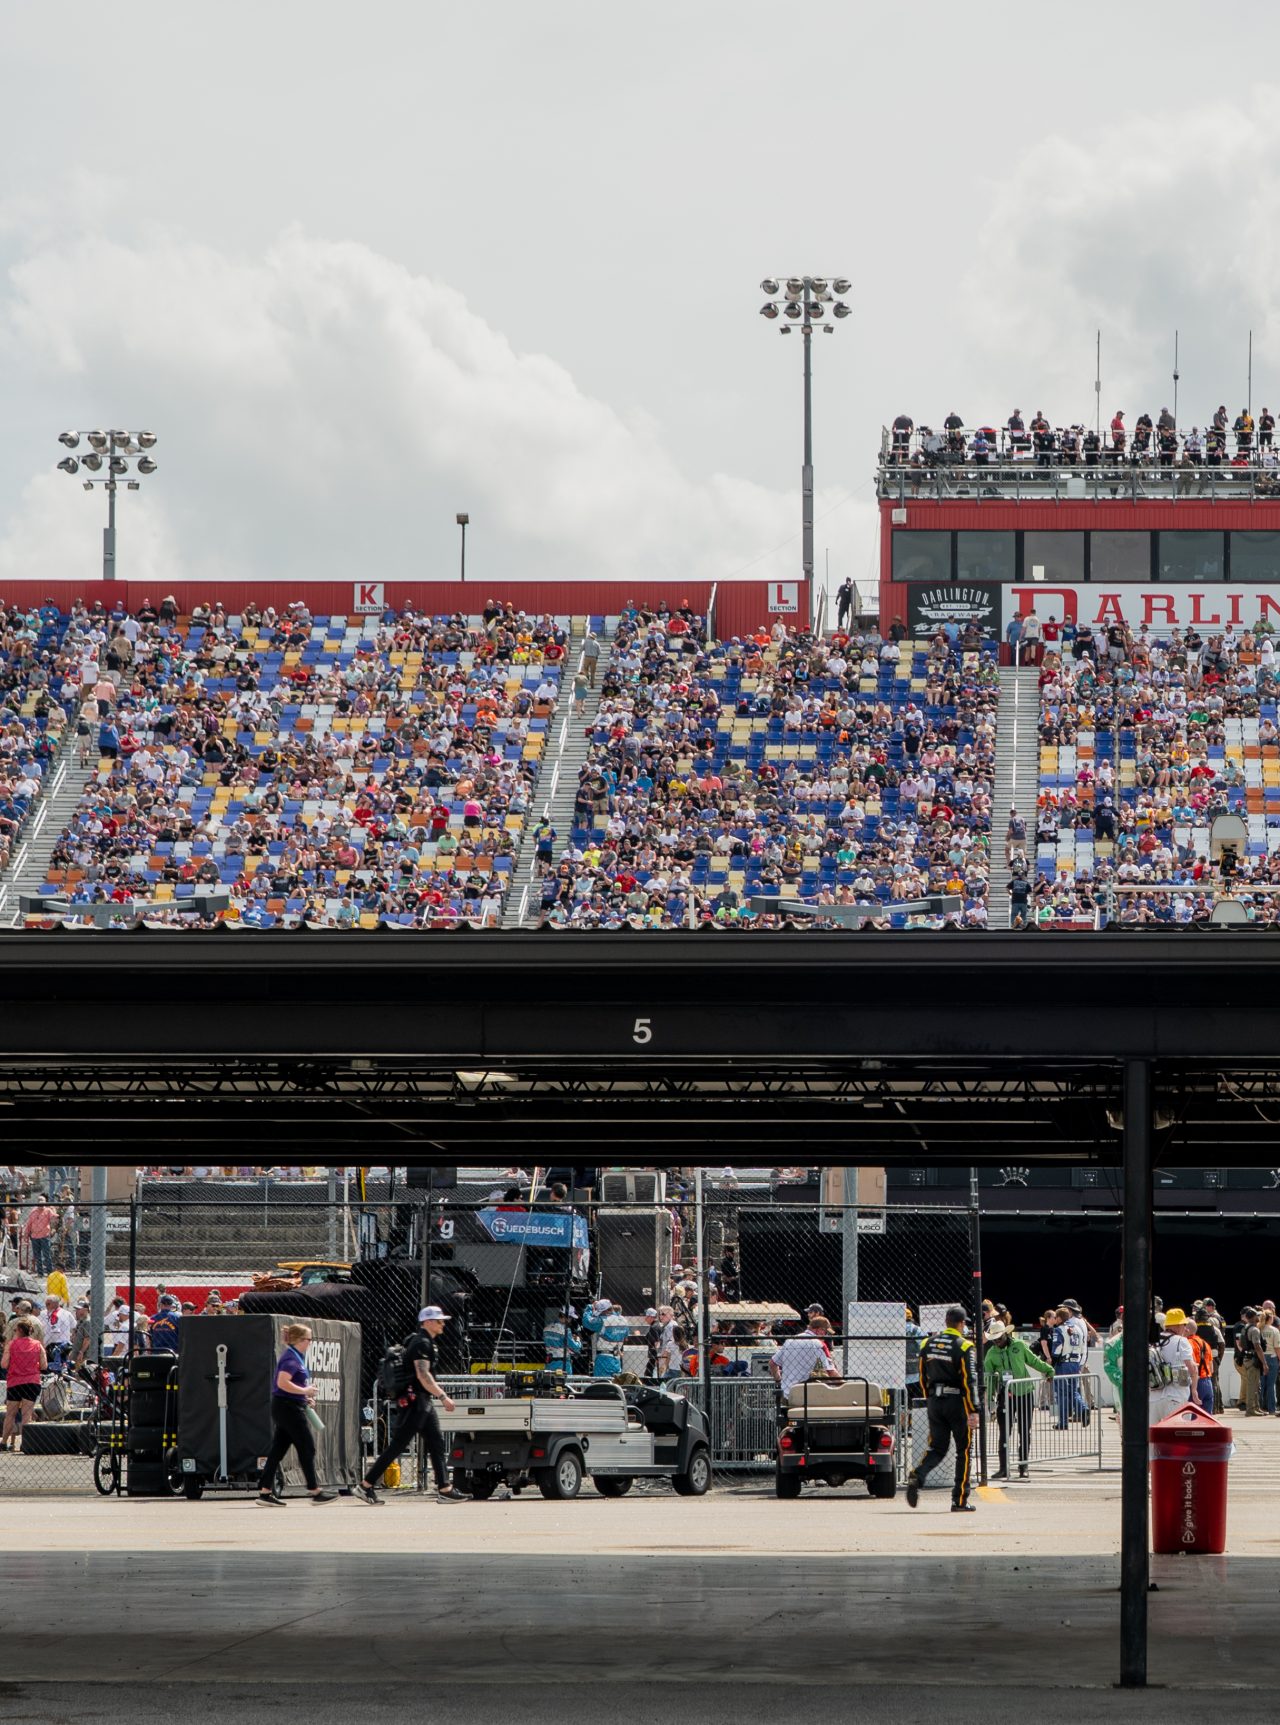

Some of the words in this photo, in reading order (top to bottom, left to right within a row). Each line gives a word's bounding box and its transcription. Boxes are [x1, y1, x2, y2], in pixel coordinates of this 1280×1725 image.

[360, 584, 377, 605] K
[776, 584, 789, 604] L
[921, 587, 990, 606] DARLINGTON
[632, 1018, 652, 1044] 5
[491, 1217, 564, 1236] RUEDEBUSCH
[305, 1340, 341, 1373] NASCAR
[523, 1418, 530, 1428] 5
[1184, 1479, 1193, 1500] back
[1184, 1499, 1193, 1508] it
[1184, 1508, 1195, 1528] give
